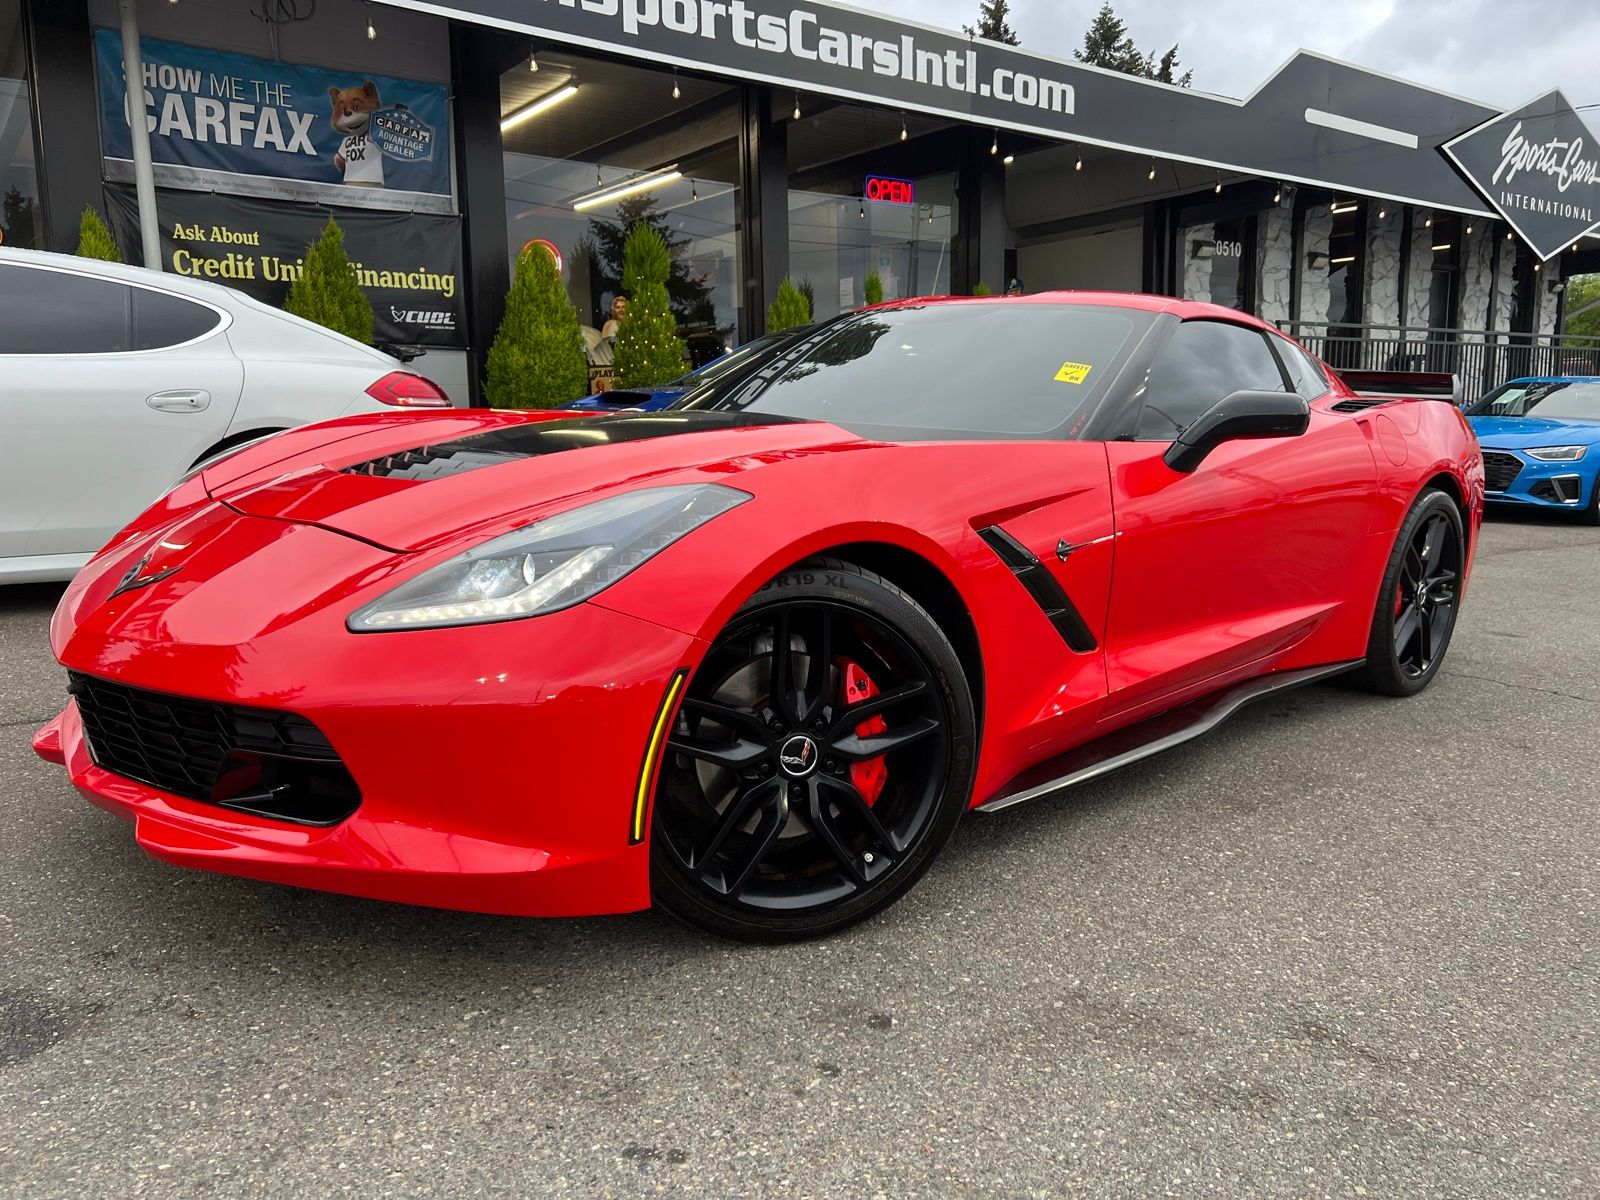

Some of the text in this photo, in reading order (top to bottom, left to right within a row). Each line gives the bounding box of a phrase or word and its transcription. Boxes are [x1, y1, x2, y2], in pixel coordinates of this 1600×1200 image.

[210, 73, 245, 101] ME
[250, 80, 292, 108] THE
[376, 117, 429, 143] CARFAX
[378, 130, 424, 152] ADVANTAGE
[345, 135, 368, 149] CAR
[383, 142, 415, 159] DEALER
[345, 148, 366, 162] FOX
[1492, 121, 1600, 193] Sports Cars
[867, 178, 912, 205] OPEN
[1501, 191, 1592, 222] INTERNATIONAL
[173, 223, 260, 246] Ask About
[1213, 240, 1242, 258] 0510
[173, 249, 256, 280] Credit
[347, 262, 455, 298] inancing
[825, 574, 850, 589] XL
